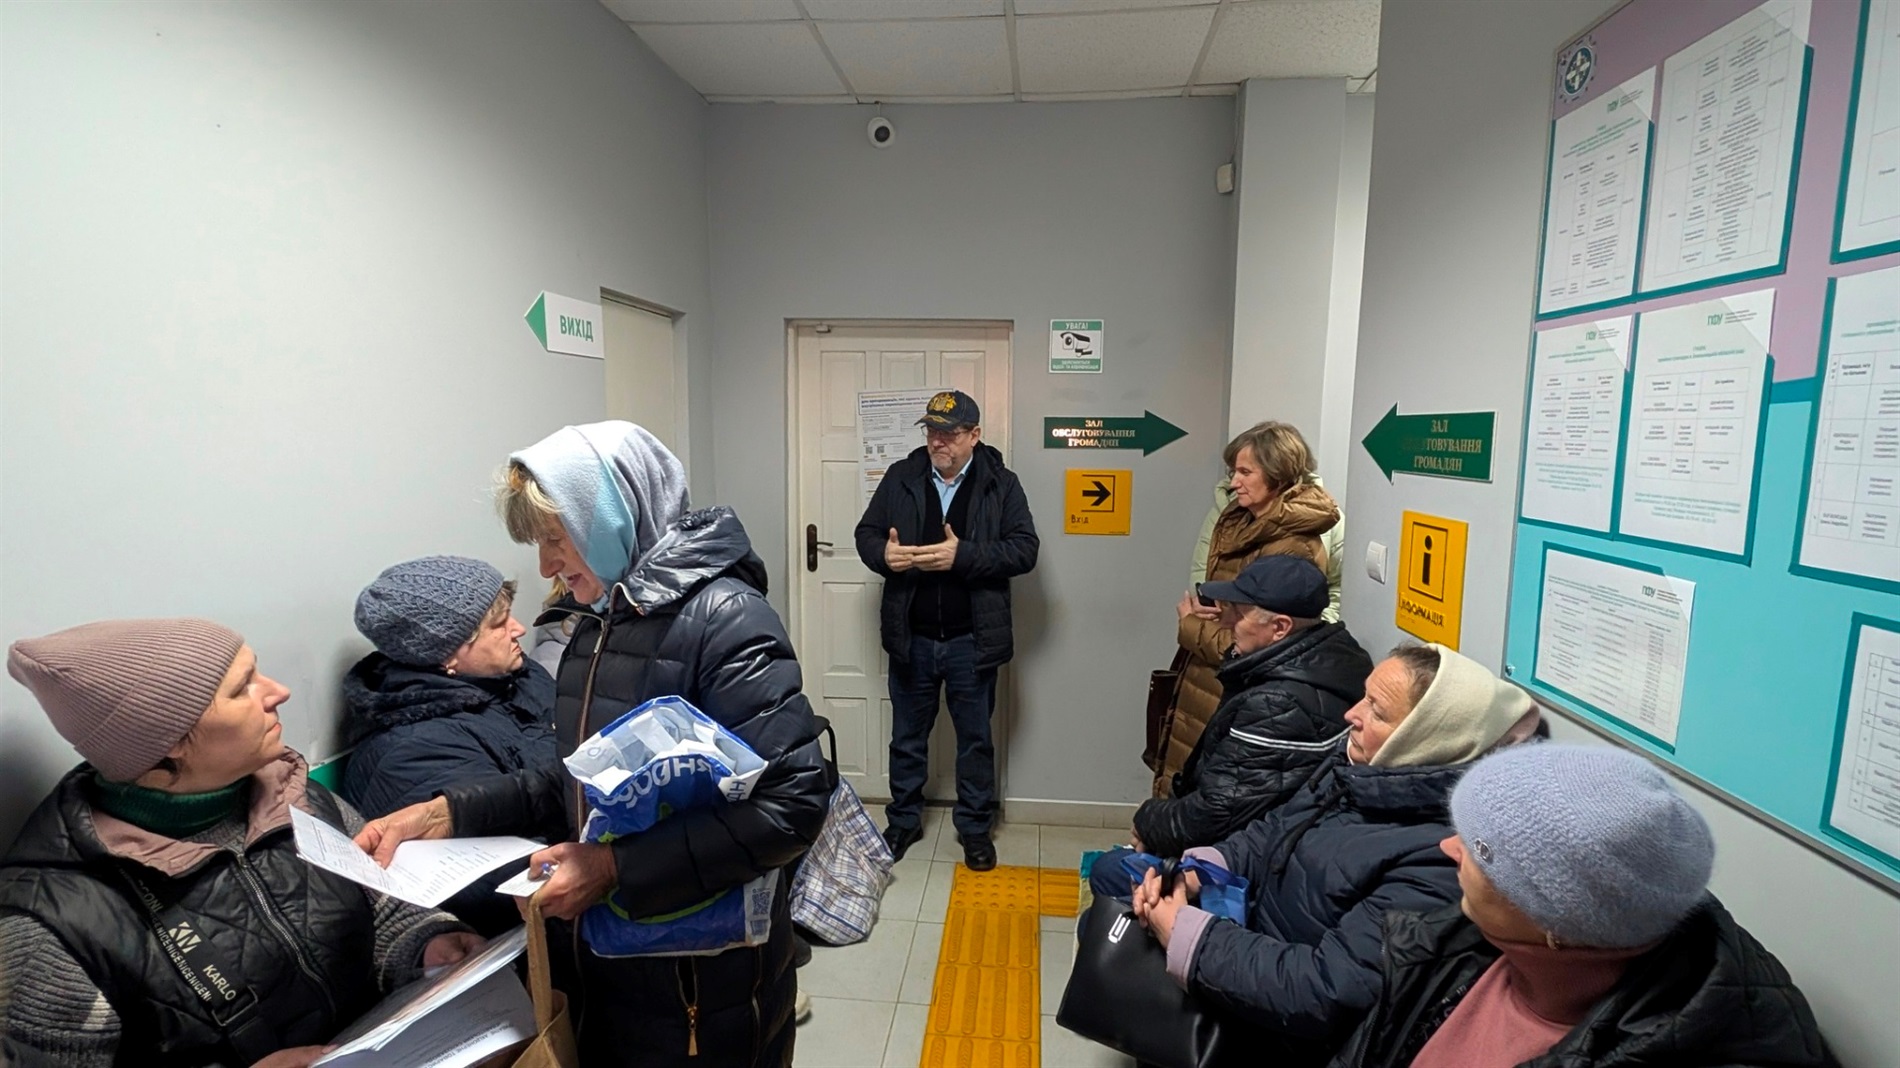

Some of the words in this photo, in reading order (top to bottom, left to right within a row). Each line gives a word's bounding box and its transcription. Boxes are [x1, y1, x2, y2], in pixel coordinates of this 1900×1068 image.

[560, 314, 594, 343] ВИХІД
[1065, 322, 1089, 330] УВАГА!
[1085, 419, 1103, 428] ЗАЛ
[1431, 419, 1449, 434] ЗАЛ
[1052, 428, 1136, 438] ОБСЛУГОВУВАННЯ
[1402, 437, 1482, 454] ГОВУВАННЯ
[1414, 455, 1463, 474] ГРОМАДЯН
[202, 963, 237, 1001] KARLO
